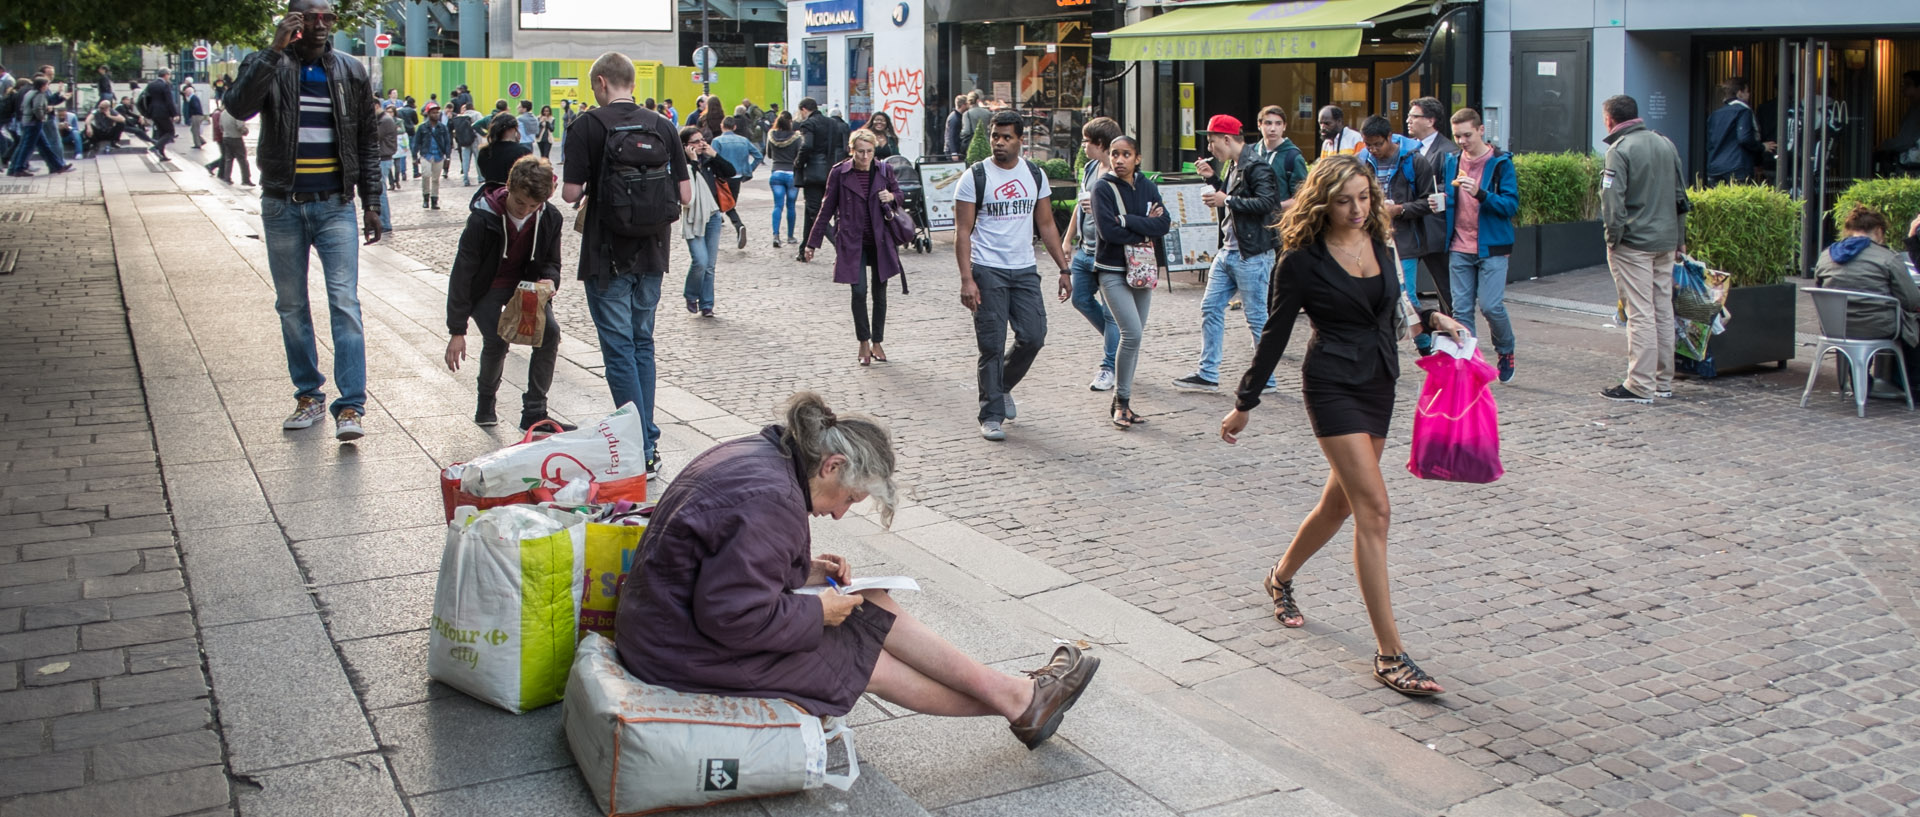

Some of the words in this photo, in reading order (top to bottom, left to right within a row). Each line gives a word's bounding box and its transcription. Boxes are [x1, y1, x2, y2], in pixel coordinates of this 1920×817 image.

[804, 8, 857, 27] MICROMANIA
[1155, 39, 1246, 57] SANDWICH
[986, 201, 1010, 216] KNKY
[450, 646, 479, 670] city
